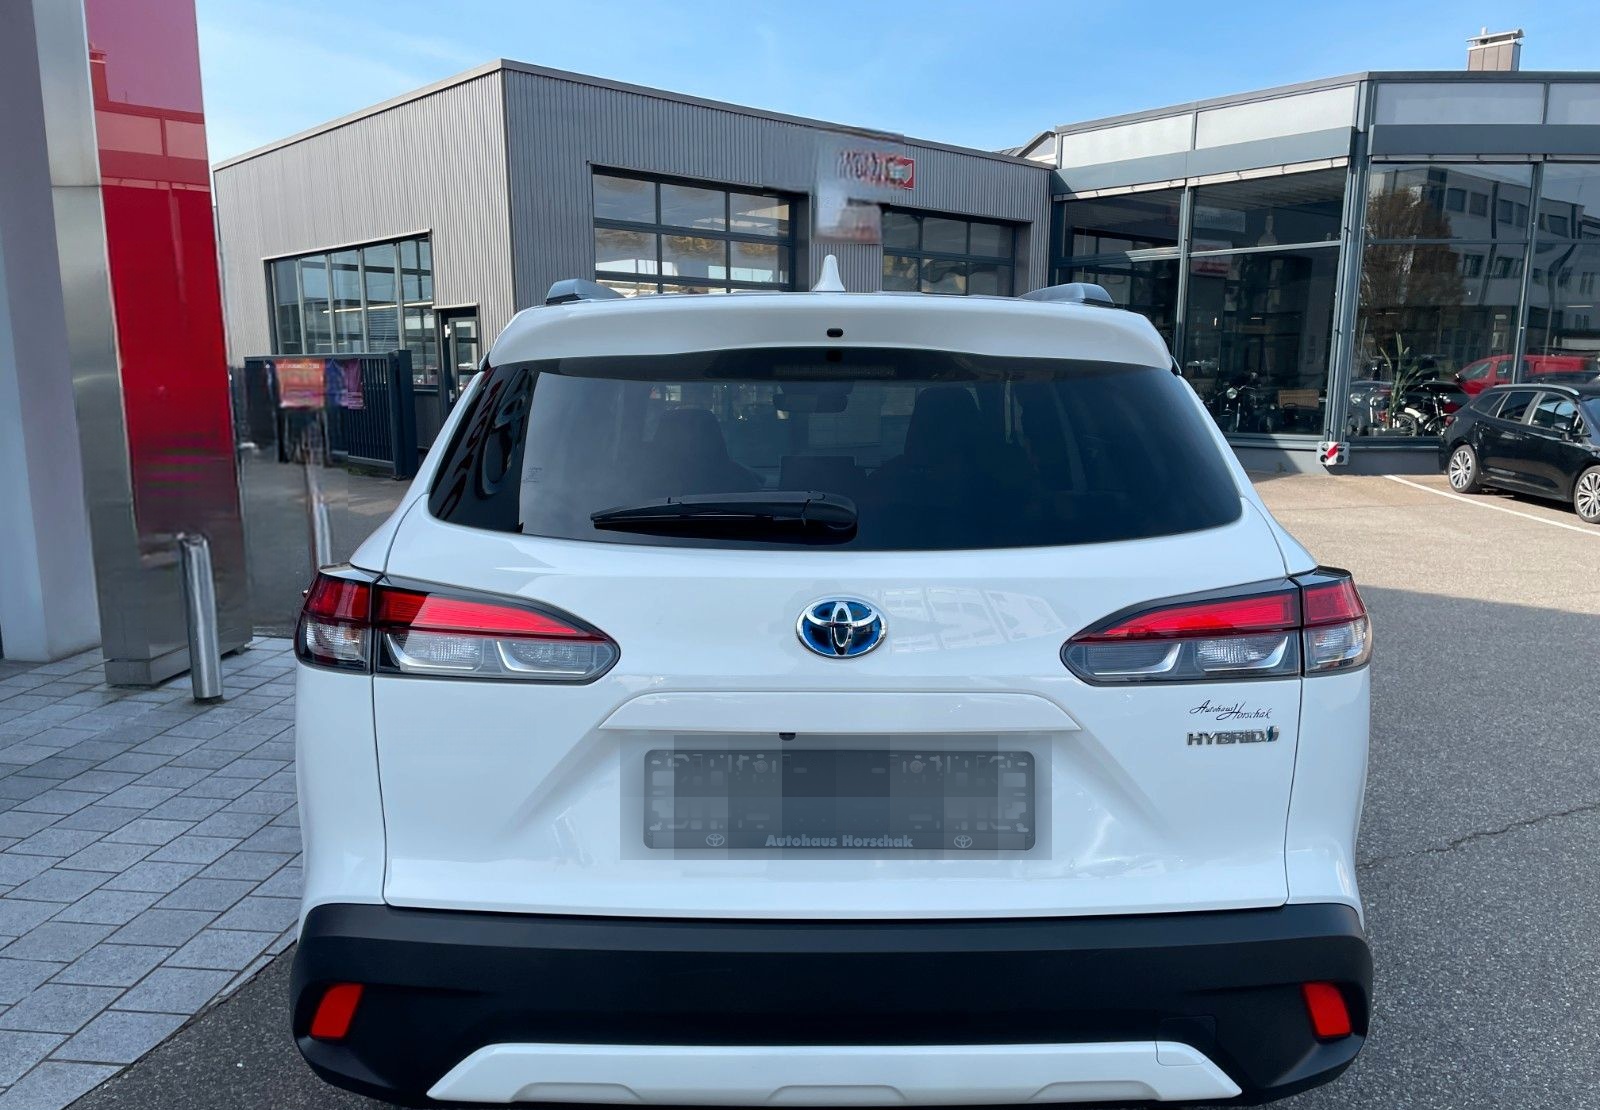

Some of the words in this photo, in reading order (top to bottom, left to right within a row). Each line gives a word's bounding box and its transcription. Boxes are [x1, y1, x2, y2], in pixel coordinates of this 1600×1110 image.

[1190, 700, 1234, 714] Autohaus
[1216, 701, 1272, 720] Horschak
[1187, 730, 1267, 745] HYBRID
[765, 834, 837, 847] Autohaus
[842, 834, 913, 848] Horschak
